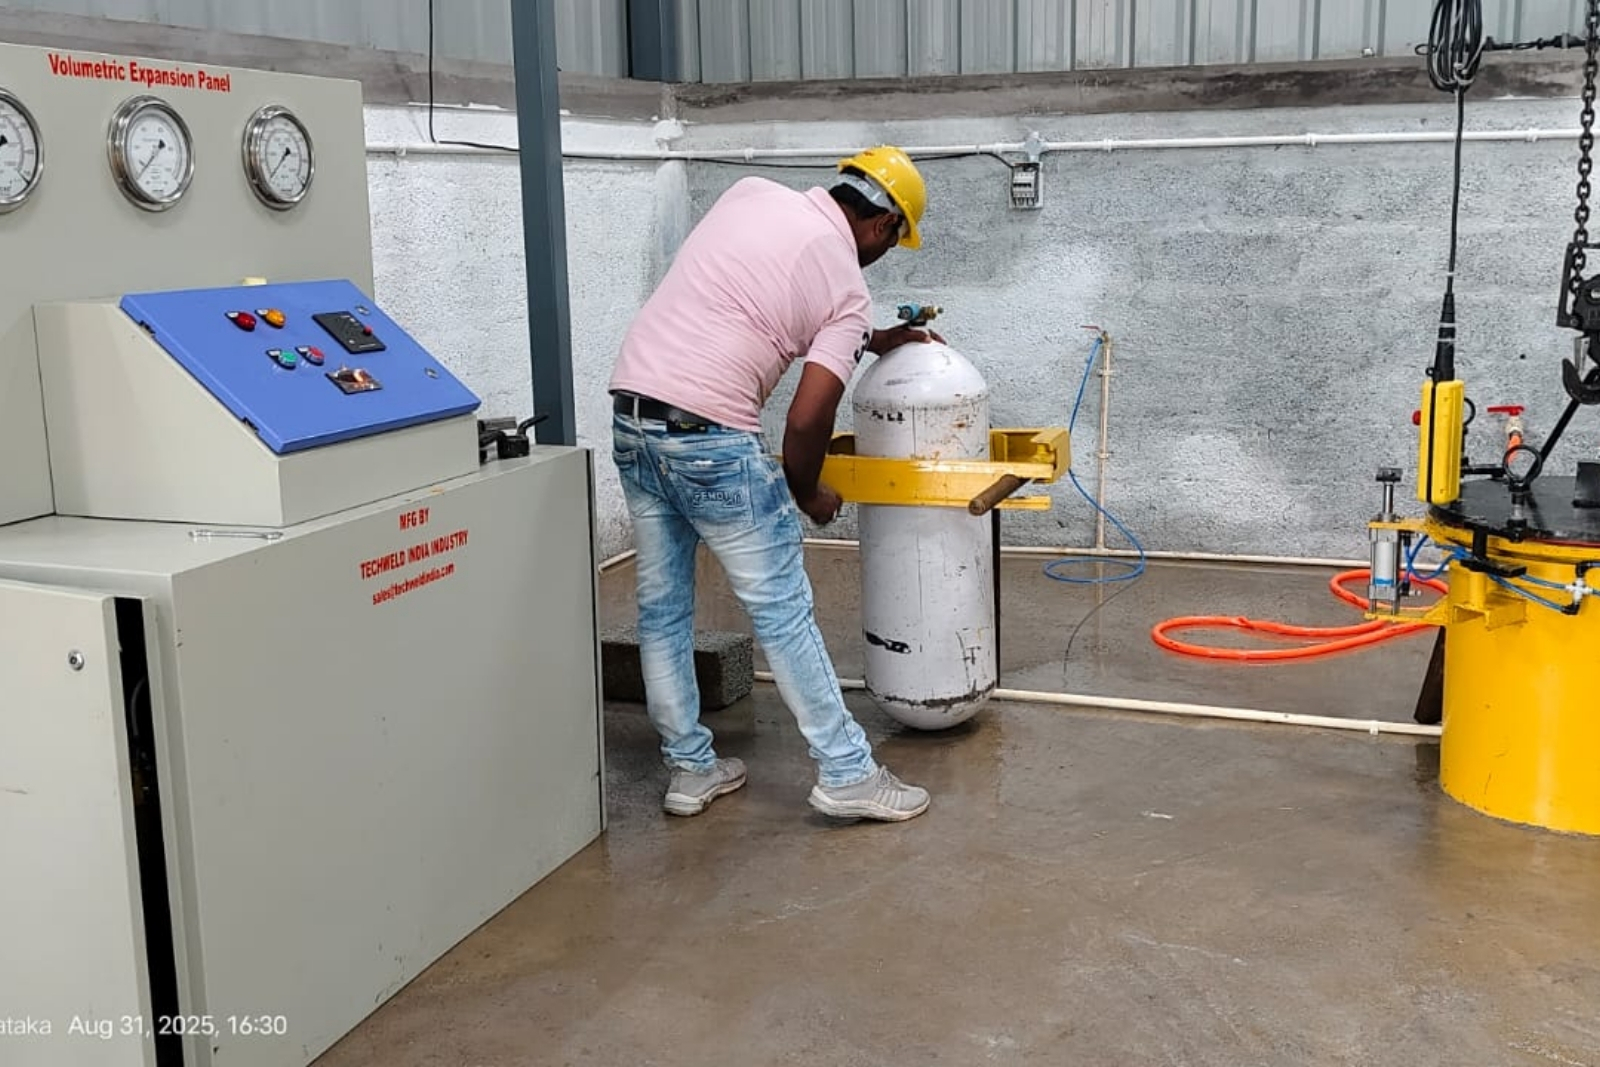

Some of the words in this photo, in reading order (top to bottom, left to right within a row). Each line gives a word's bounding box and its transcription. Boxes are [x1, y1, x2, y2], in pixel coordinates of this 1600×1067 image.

[48, 53, 126, 80] Volumetric
[129, 61, 196, 88] Expansion
[199, 70, 231, 92] Panel
[399, 510, 417, 530] MFG
[418, 508, 429, 525] BY
[360, 550, 406, 580] TECHWELD
[408, 543, 430, 563] INDIA
[431, 530, 468, 556] INDUSTRY
